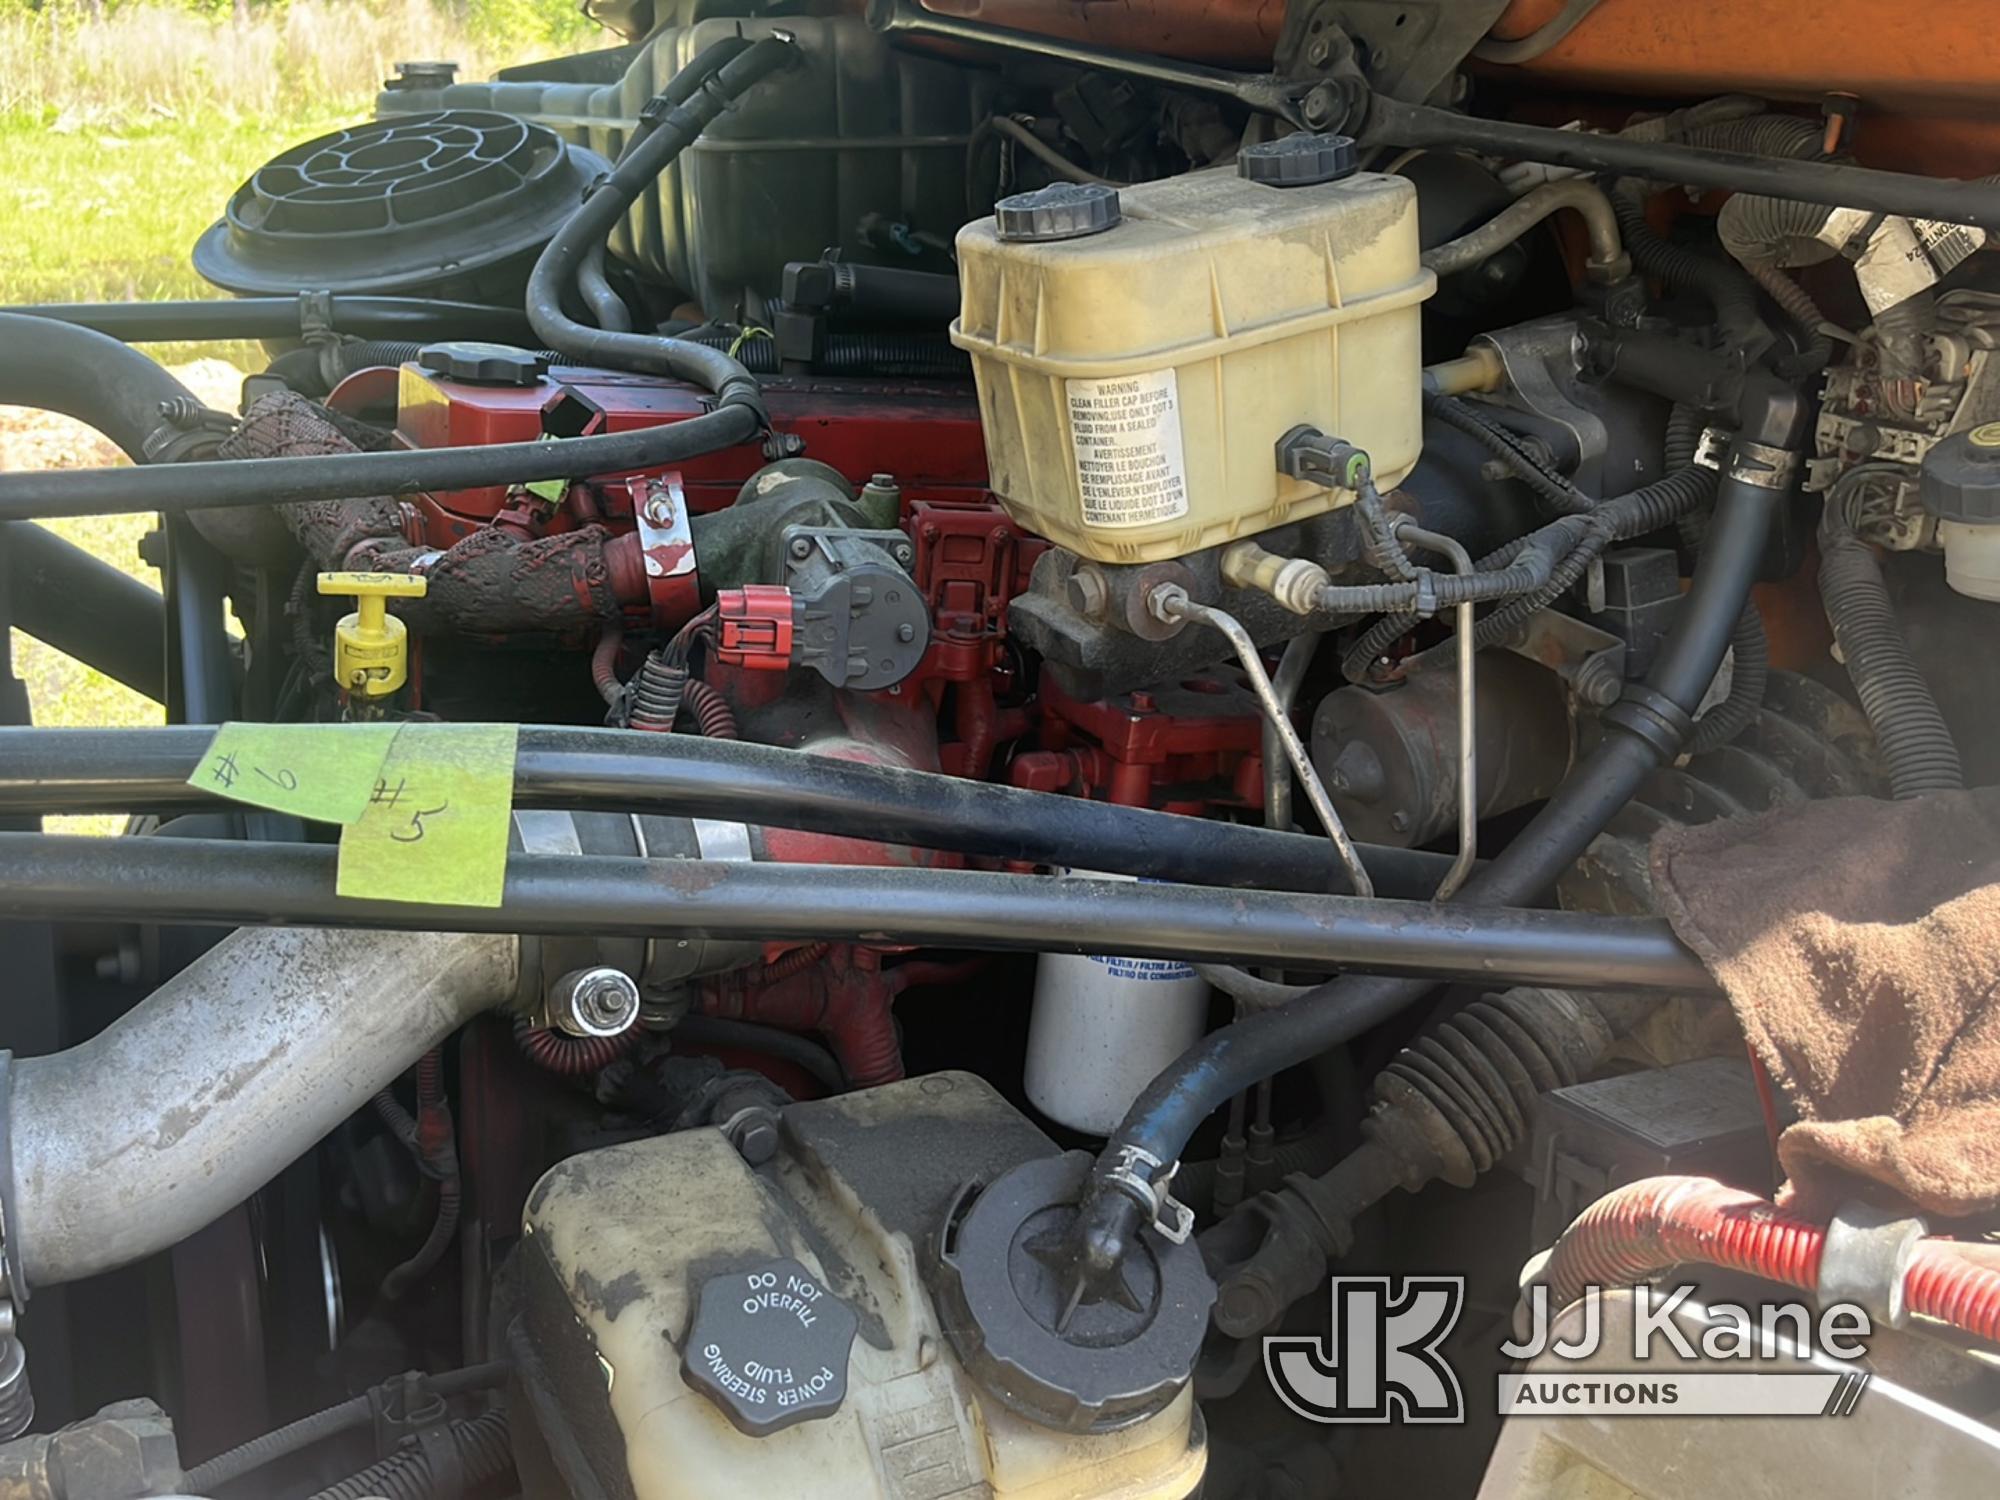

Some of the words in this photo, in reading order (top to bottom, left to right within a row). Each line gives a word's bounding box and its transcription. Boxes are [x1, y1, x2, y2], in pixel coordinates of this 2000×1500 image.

[1097, 381, 1139, 395] WARNING
[1071, 399, 1092, 408] CLEAN
[1093, 397, 1120, 408] FILLER
[1122, 395, 1137, 406] CAP
[1140, 388, 1168, 403] BEFORE
[1129, 408, 1149, 418] ONLY
[1152, 402, 1167, 415] DOT
[1168, 400, 1173, 409] 3
[1074, 423, 1093, 433] FLUID
[1095, 423, 1117, 434] FROM
[1119, 423, 1125, 432] A
[1127, 418, 1156, 431] SEALED
[1094, 443, 1157, 458] AVERTISSEMENT
[1079, 459, 1114, 471] NETTOYER
[1116, 460, 1125, 471] LE
[1128, 455, 1166, 470] BOUCHON
[1081, 473, 1089, 483] DE
[1091, 472, 1143, 484] REMPLISSAGE
[1145, 466, 1169, 480] AVANT
[1082, 485, 1091, 496] DE
[1084, 498, 1097, 509] QUE
[1098, 499, 1107, 510] LE
[1110, 498, 1140, 510] LIQUIDE
[1142, 496, 1157, 507] DOT
[1160, 493, 1165, 503] 3
[1167, 489, 1183, 502] D'UN
[1086, 512, 1126, 523] CONTENANT
[1108, 966, 1136, 979] FILTRO
[1137, 971, 1149, 980] DE
[747, 1272, 777, 1290] DO
[786, 1275, 822, 1302] NOT
[743, 1292, 817, 1328] OVERFILL
[703, 1343, 767, 1404] STEERING
[744, 1361, 794, 1384] FLUID
[777, 1366, 834, 1406] POWER
